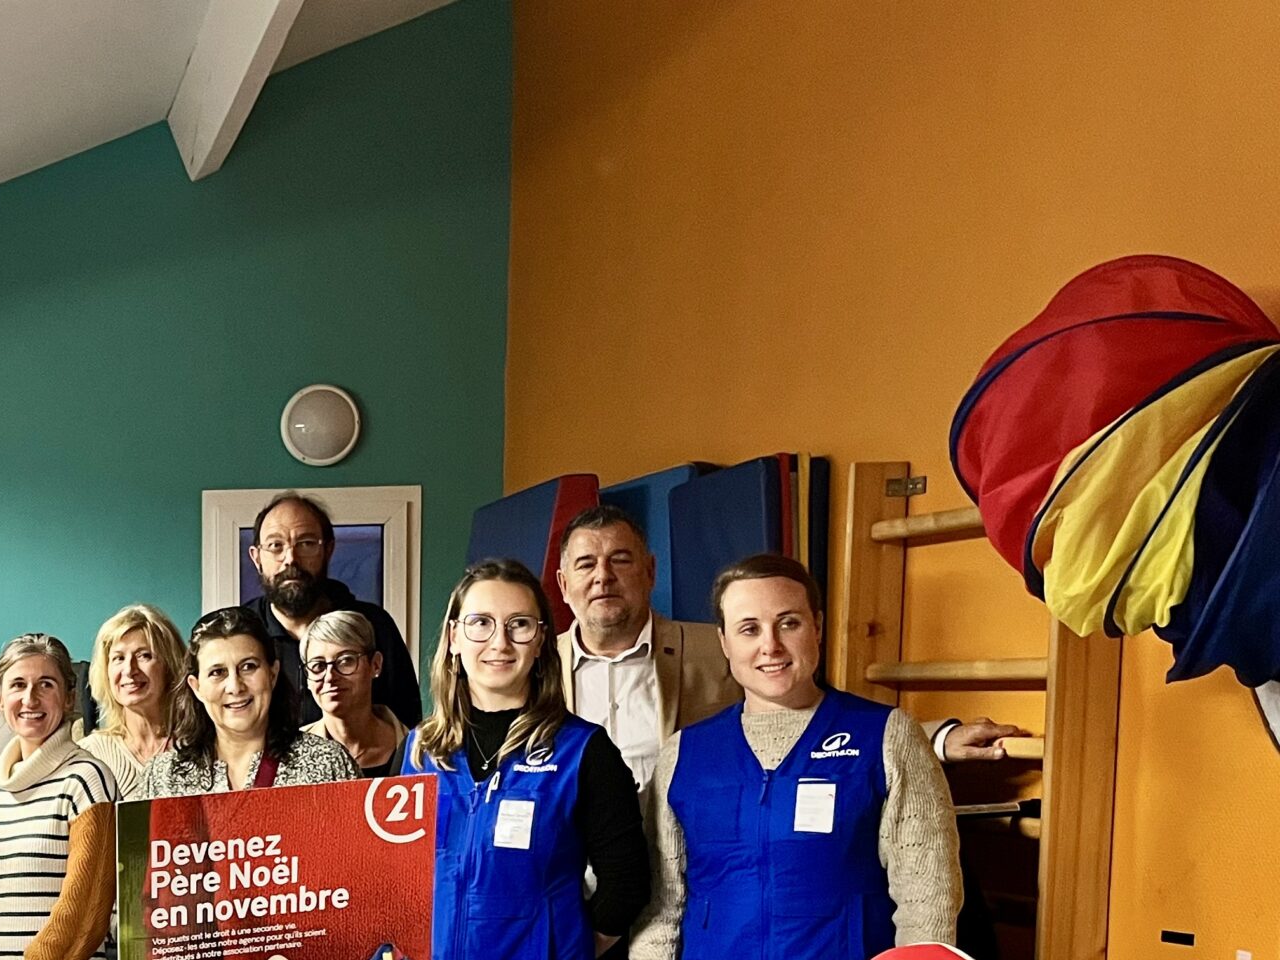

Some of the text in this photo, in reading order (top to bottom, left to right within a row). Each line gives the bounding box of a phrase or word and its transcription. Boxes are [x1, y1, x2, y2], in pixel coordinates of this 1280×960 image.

[811, 749, 859, 759] DECATHLON
[513, 763, 557, 772] DECATHLON
[385, 782, 424, 822] 21
[151, 835, 281, 868] Devenez
[151, 856, 298, 899] Père Noël
[150, 887, 349, 929] en novembre
[167, 935, 189, 945] jouets
[213, 929, 230, 937] droit
[253, 923, 283, 933] seconde
[199, 941, 217, 949] dans
[218, 939, 237, 947] notre
[239, 936, 265, 945] agence
[266, 934, 283, 943] pour
[304, 929, 326, 937] soient
[202, 950, 221, 958] notre
[223, 945, 263, 956] association
